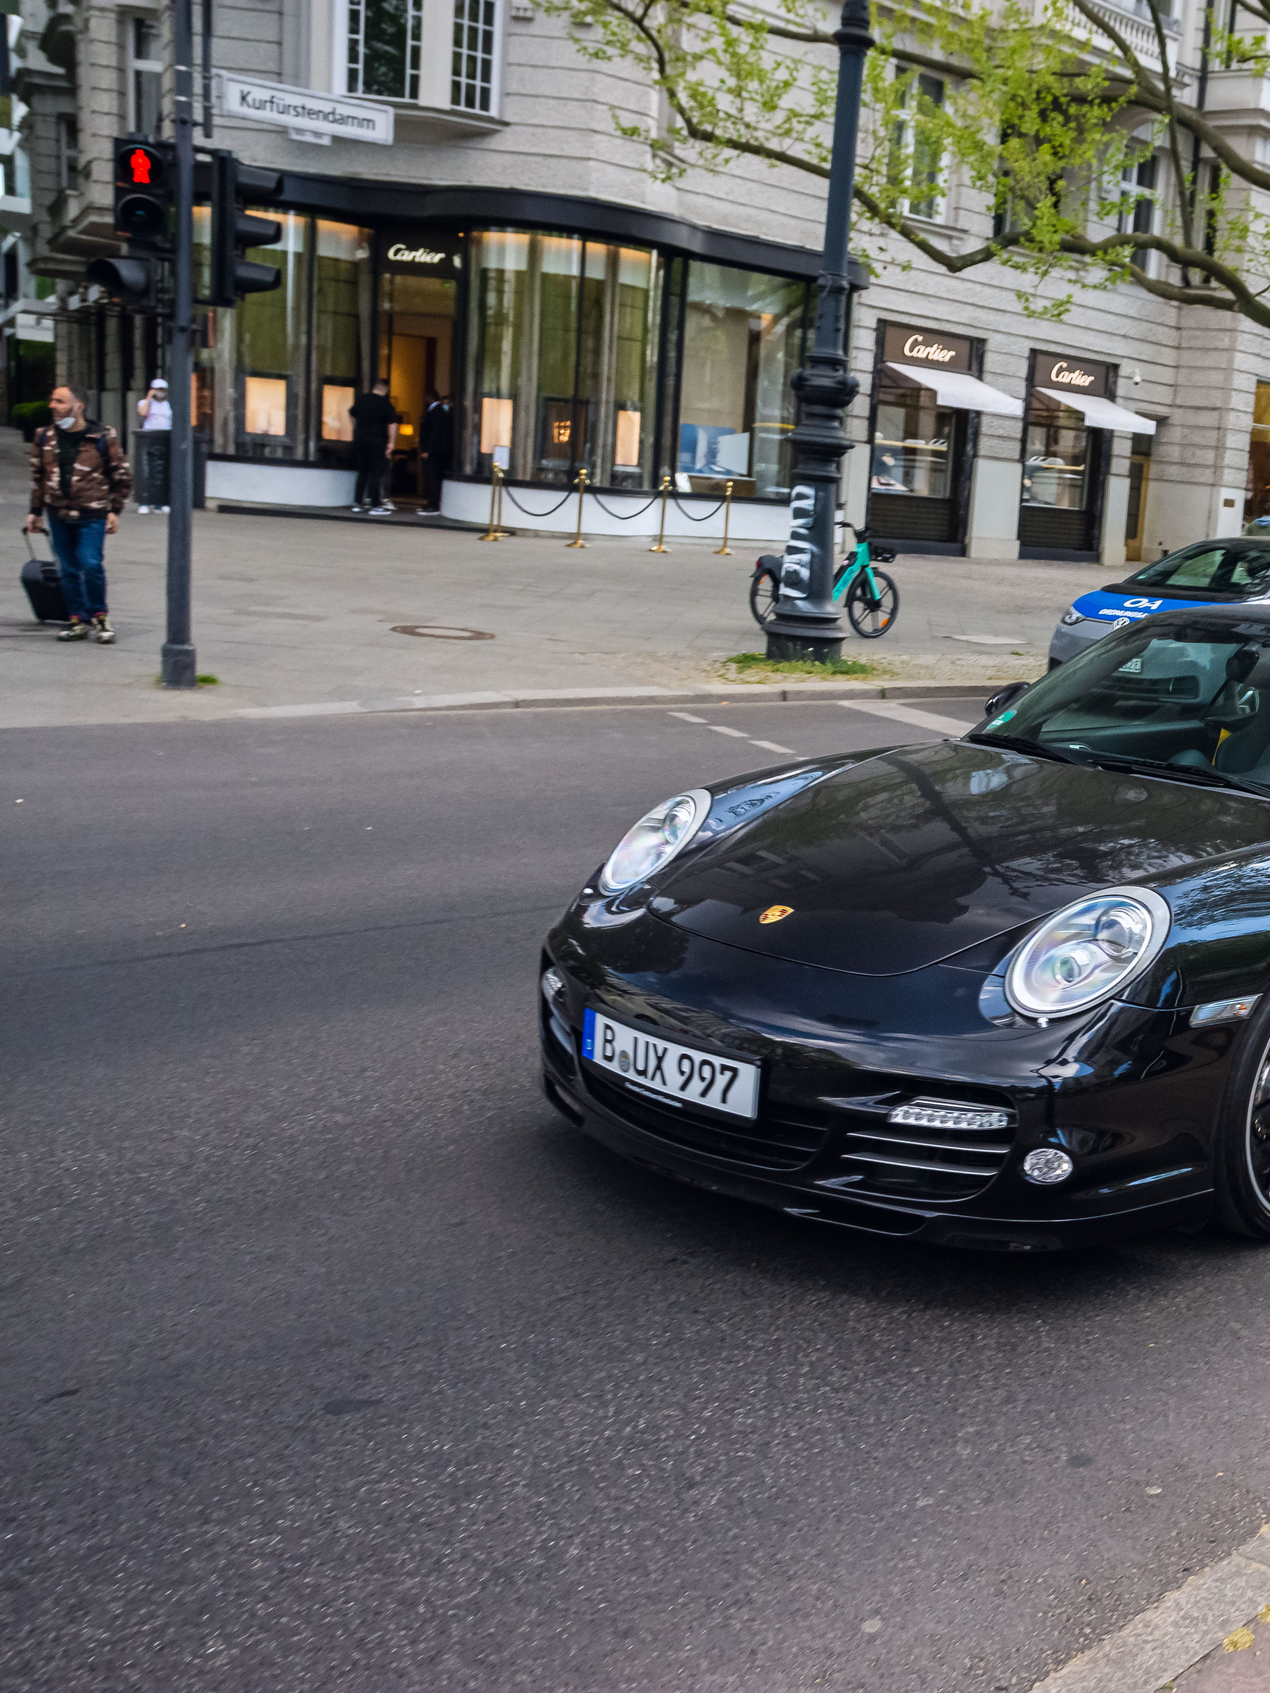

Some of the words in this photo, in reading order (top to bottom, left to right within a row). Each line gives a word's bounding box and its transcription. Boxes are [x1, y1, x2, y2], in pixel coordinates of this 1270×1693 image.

[239, 90, 376, 131] Kurfürstendamm
[387, 243, 446, 263] Cartier
[903, 334, 956, 362] Cartier
[1050, 361, 1095, 387] Cartier
[603, 1022, 616, 1063] B
[633, 1036, 669, 1087] UX
[678, 1053, 740, 1105] 997
